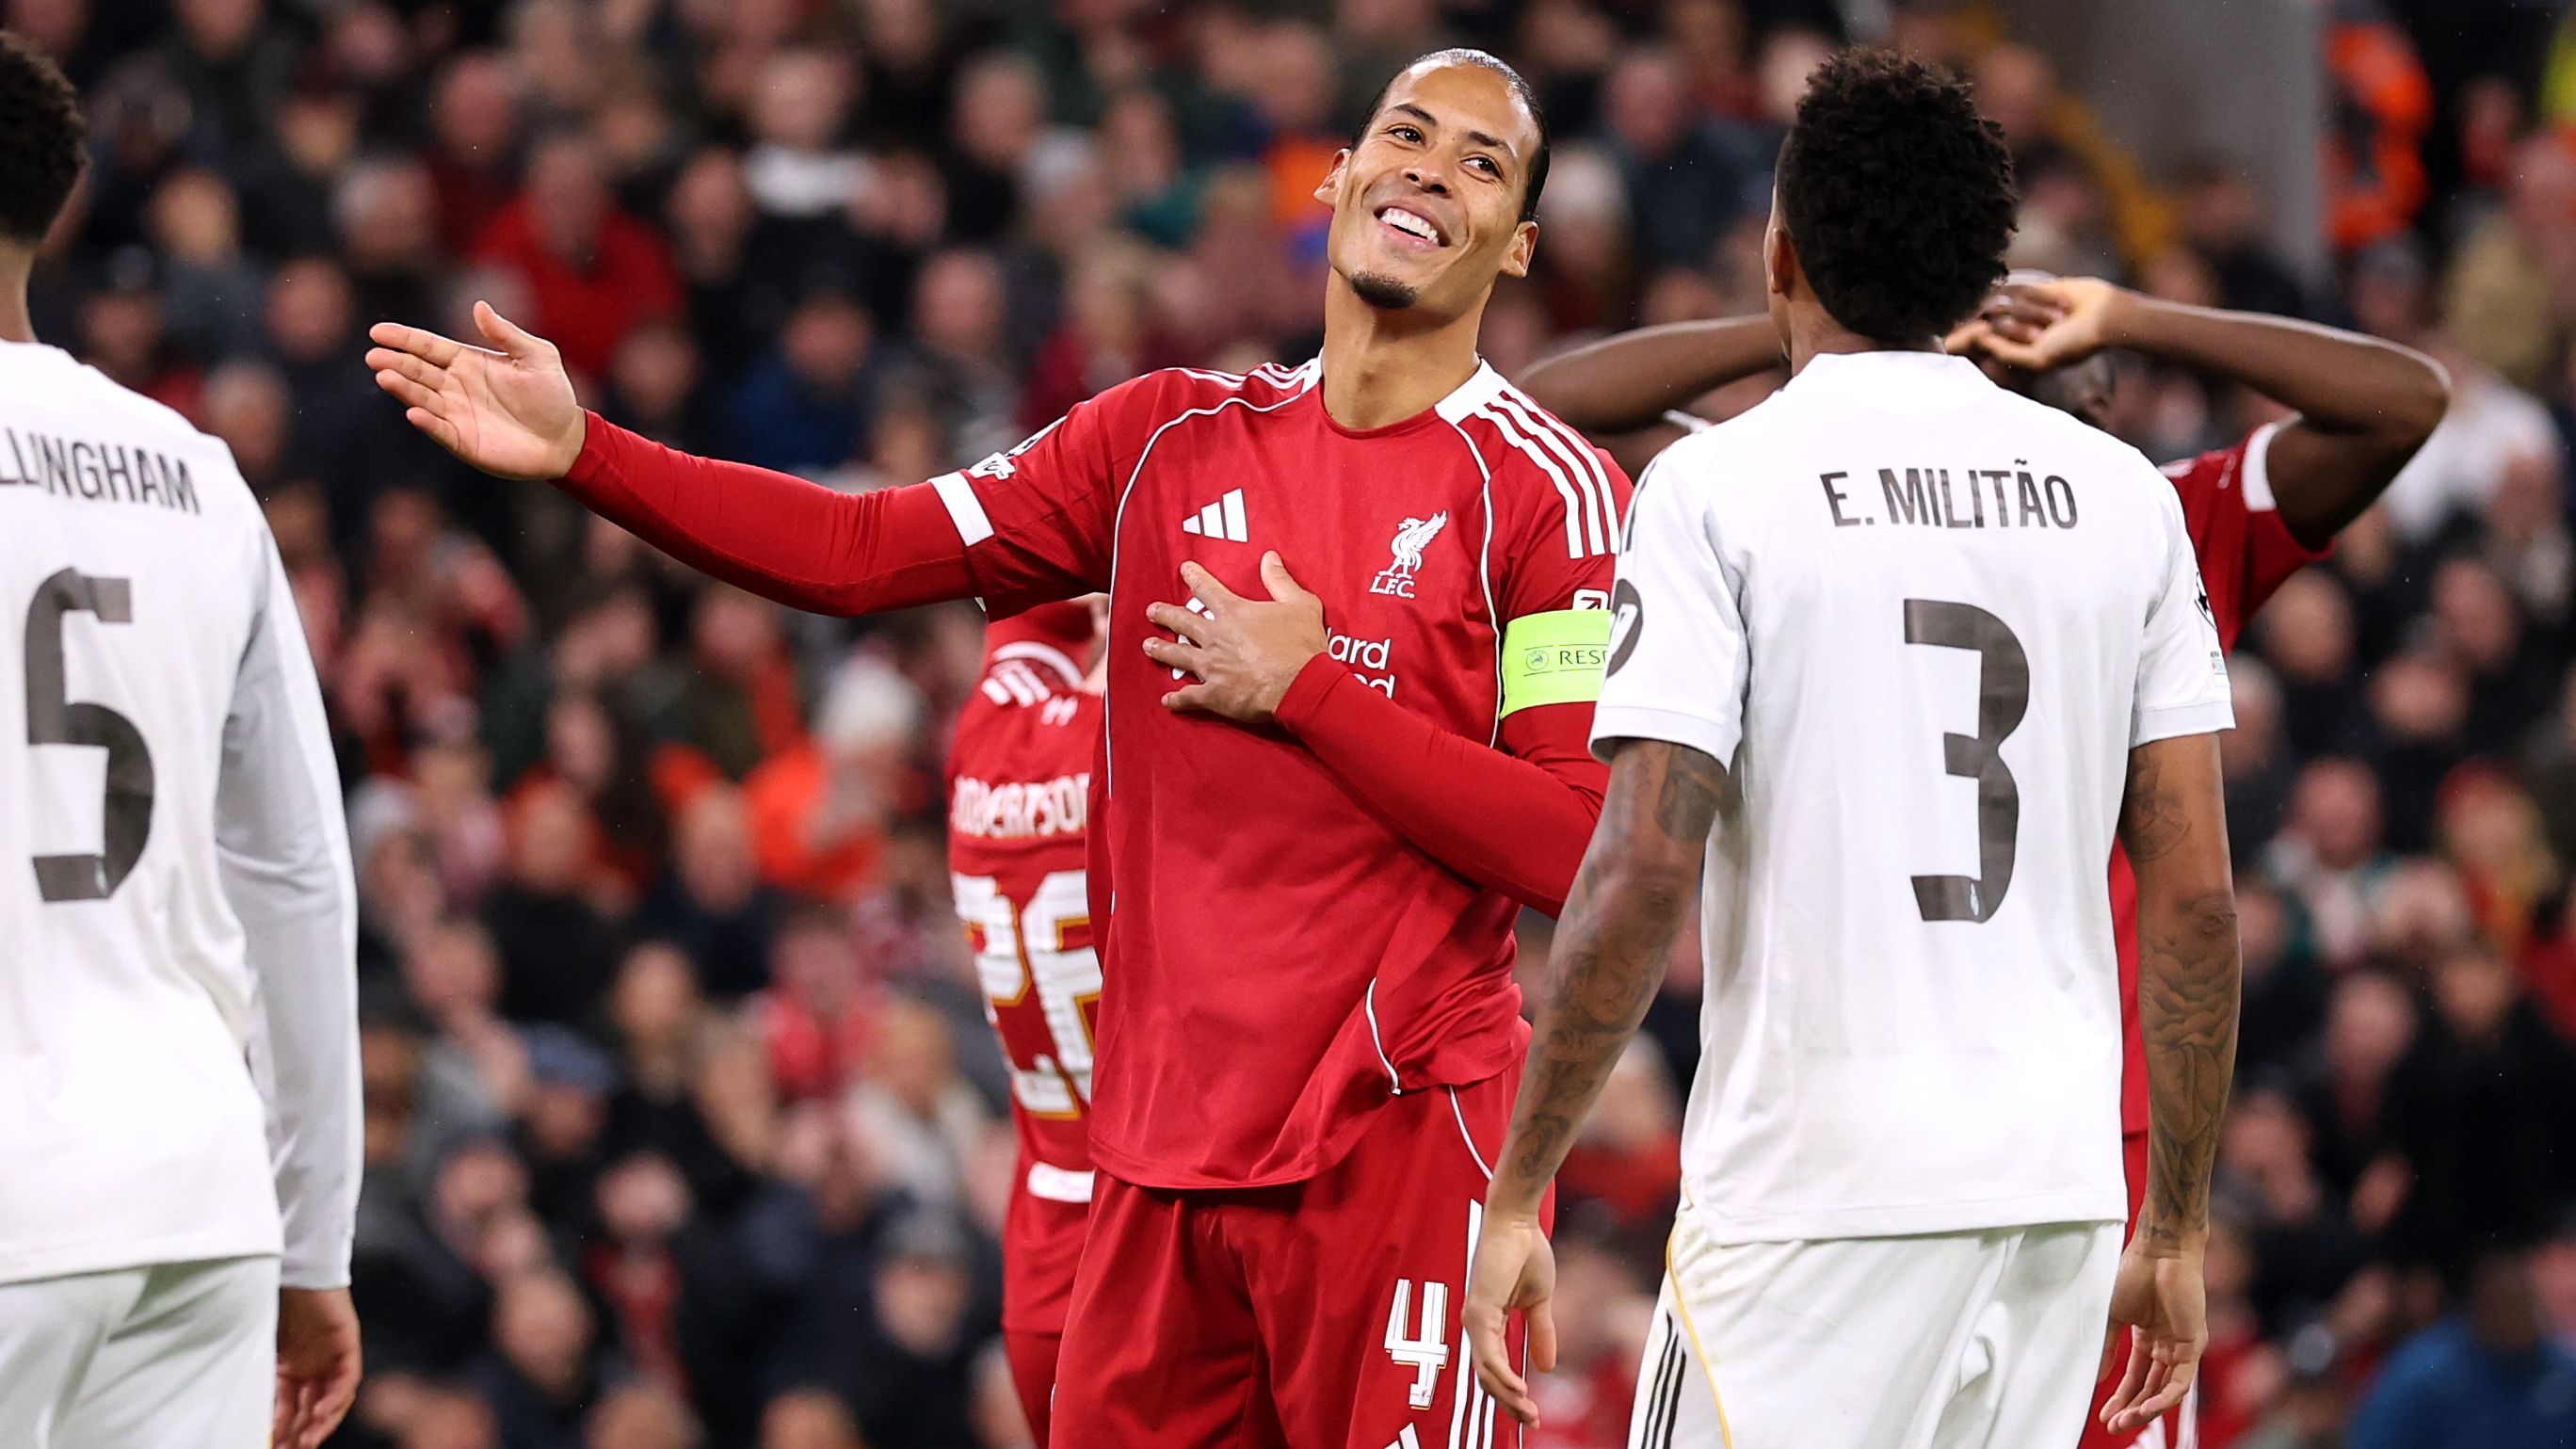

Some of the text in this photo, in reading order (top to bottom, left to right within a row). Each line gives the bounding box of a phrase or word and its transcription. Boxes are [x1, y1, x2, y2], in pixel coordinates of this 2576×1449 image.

[0, 427, 201, 514] LINGHAM
[1820, 459, 2078, 529] E. MILITÃO
[24, 566, 155, 902] 5
[1904, 599, 2030, 924] 3
[1384, 1279, 1449, 1410] 4
